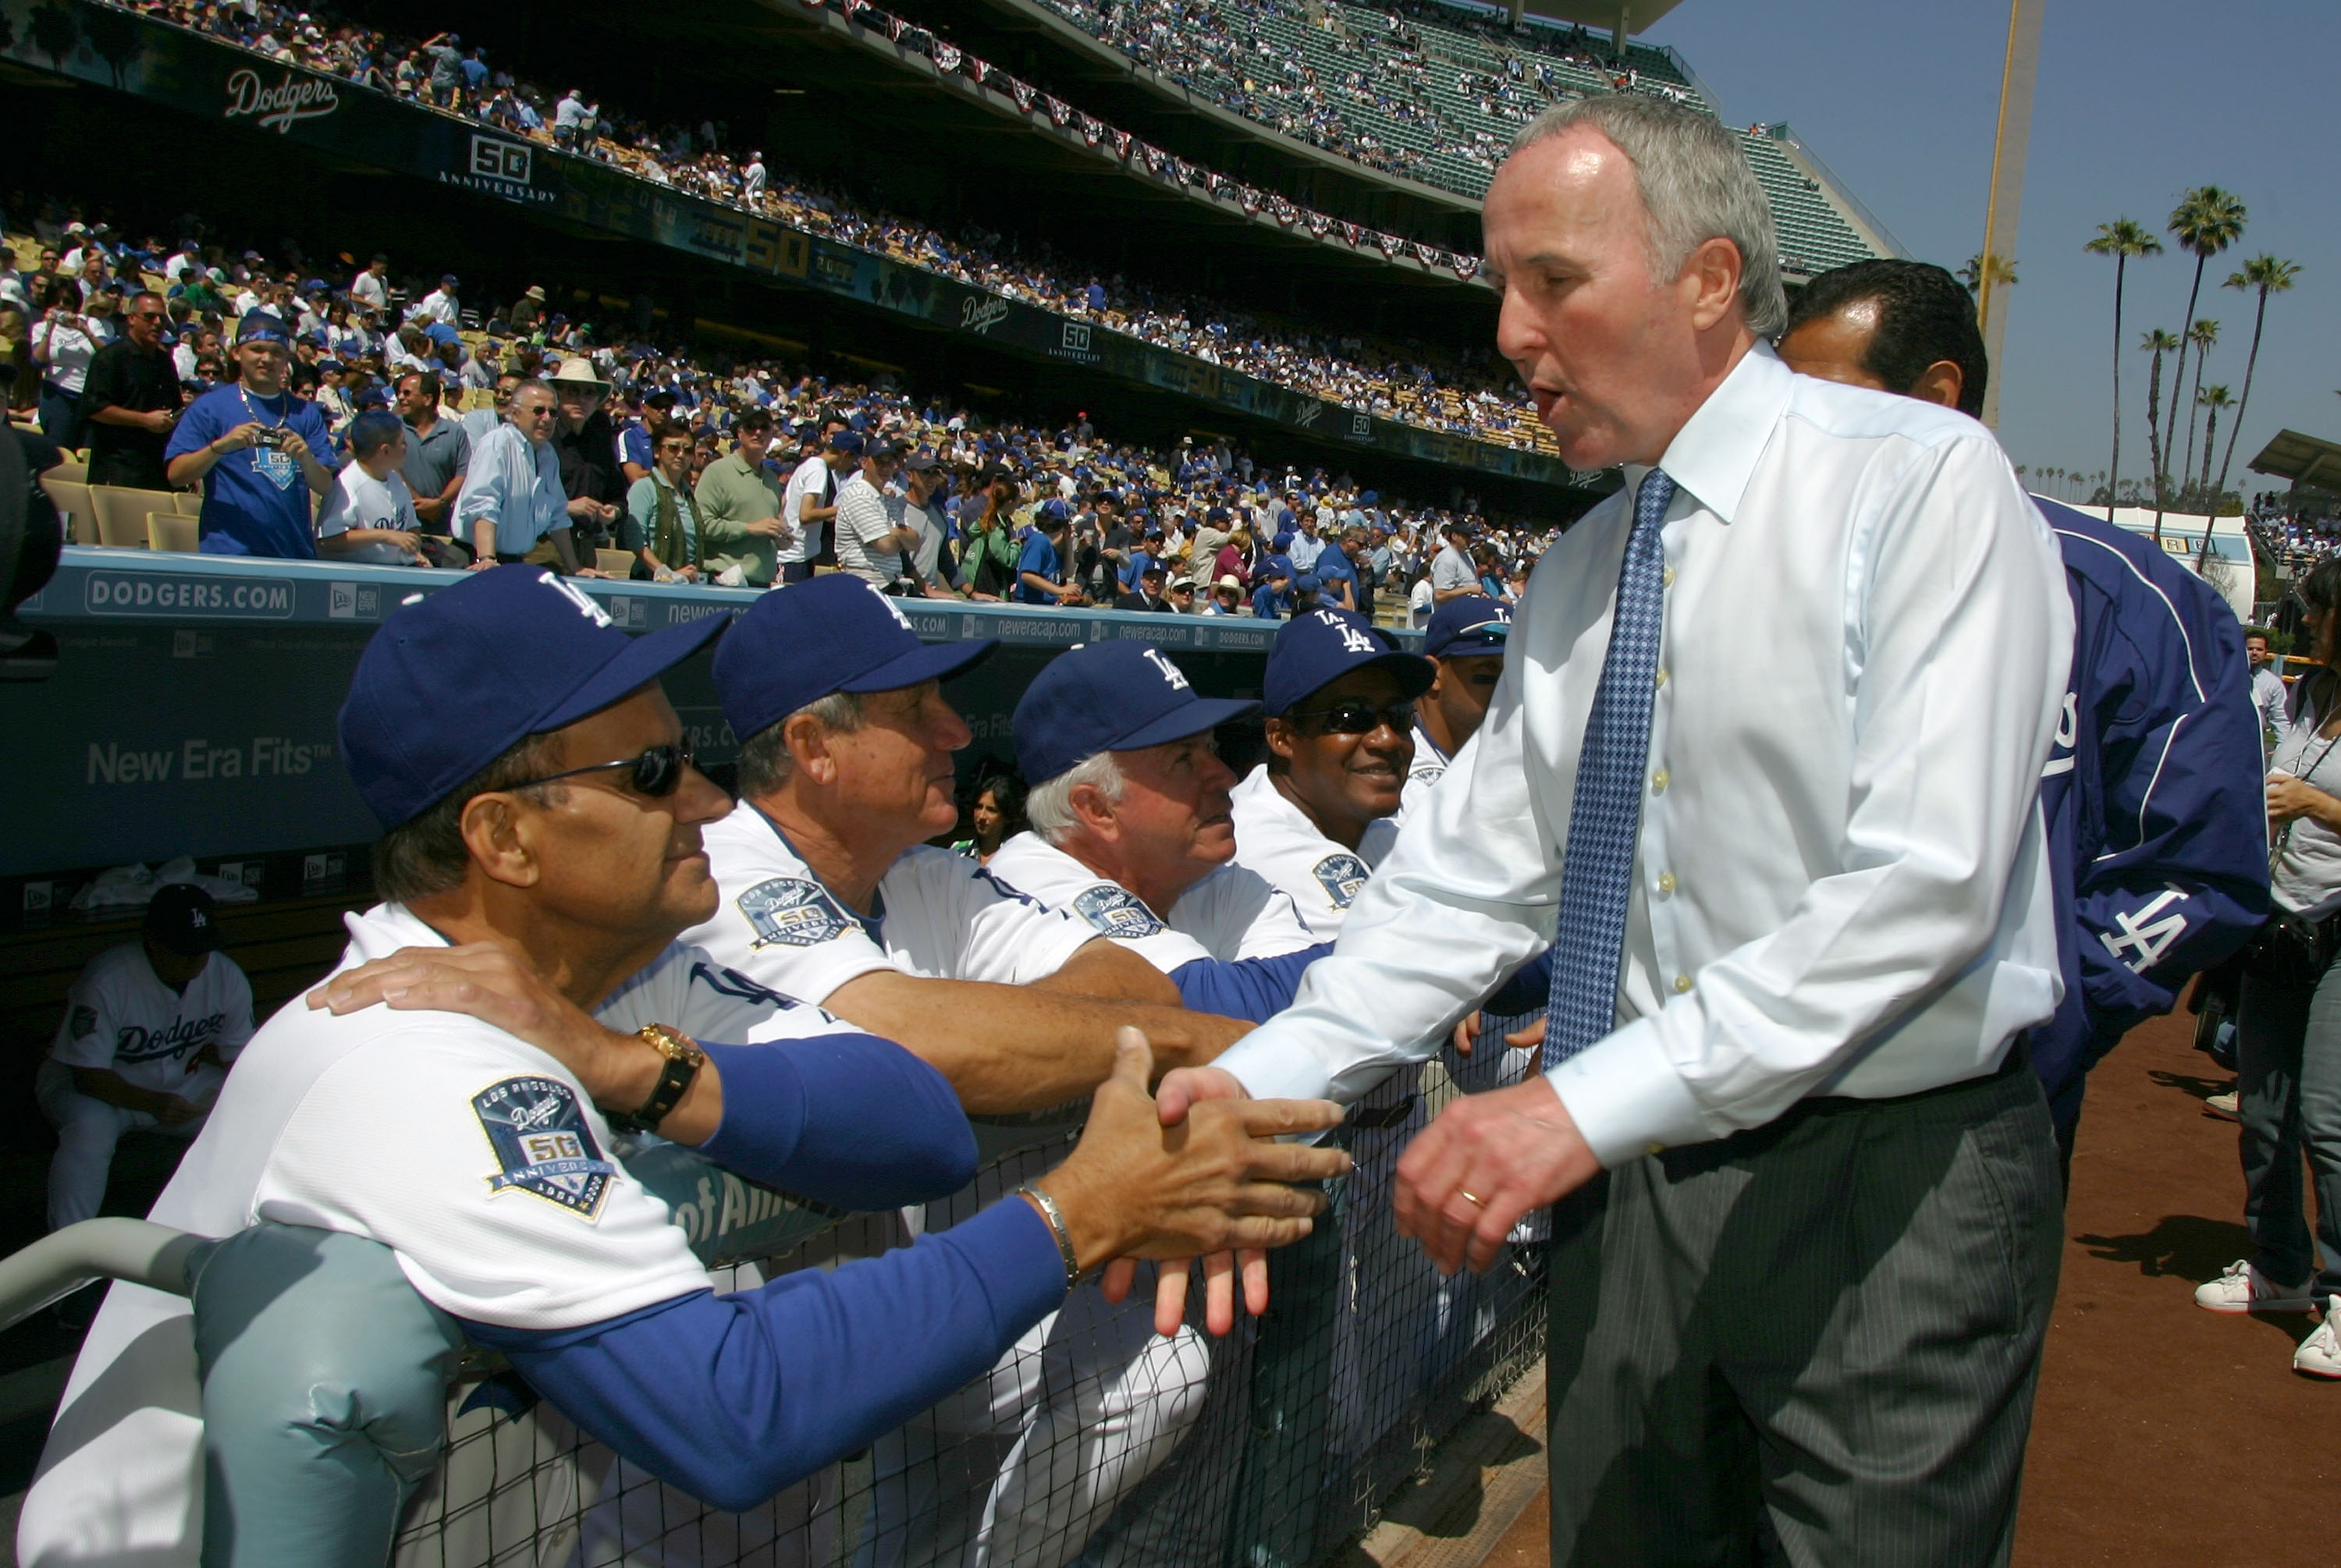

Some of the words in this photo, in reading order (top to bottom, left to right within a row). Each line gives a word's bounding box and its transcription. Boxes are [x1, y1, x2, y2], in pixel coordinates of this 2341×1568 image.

[225, 69, 339, 134] Dodgers
[475, 140, 528, 179] 50
[437, 171, 556, 203] ANNIVERSARY
[961, 296, 1009, 335] Dodgers
[92, 580, 289, 610] DODGERS.COM
[998, 619, 1080, 640] neweracap.com
[1119, 625, 1186, 644] neweracap.com
[1219, 631, 1265, 645] DODGERS.COM
[1335, 623, 1376, 652] LA
[1143, 649, 1189, 690] LA
[87, 742, 175, 785] New
[182, 739, 243, 779] Era
[190, 907, 207, 928] LA
[780, 907, 822, 925] 50
[2100, 882, 2190, 974] LA
[482, 1087, 508, 1109] LOS
[511, 1093, 561, 1131] Dodgers
[528, 1136, 582, 1162] 50
[675, 1176, 716, 1243] of
